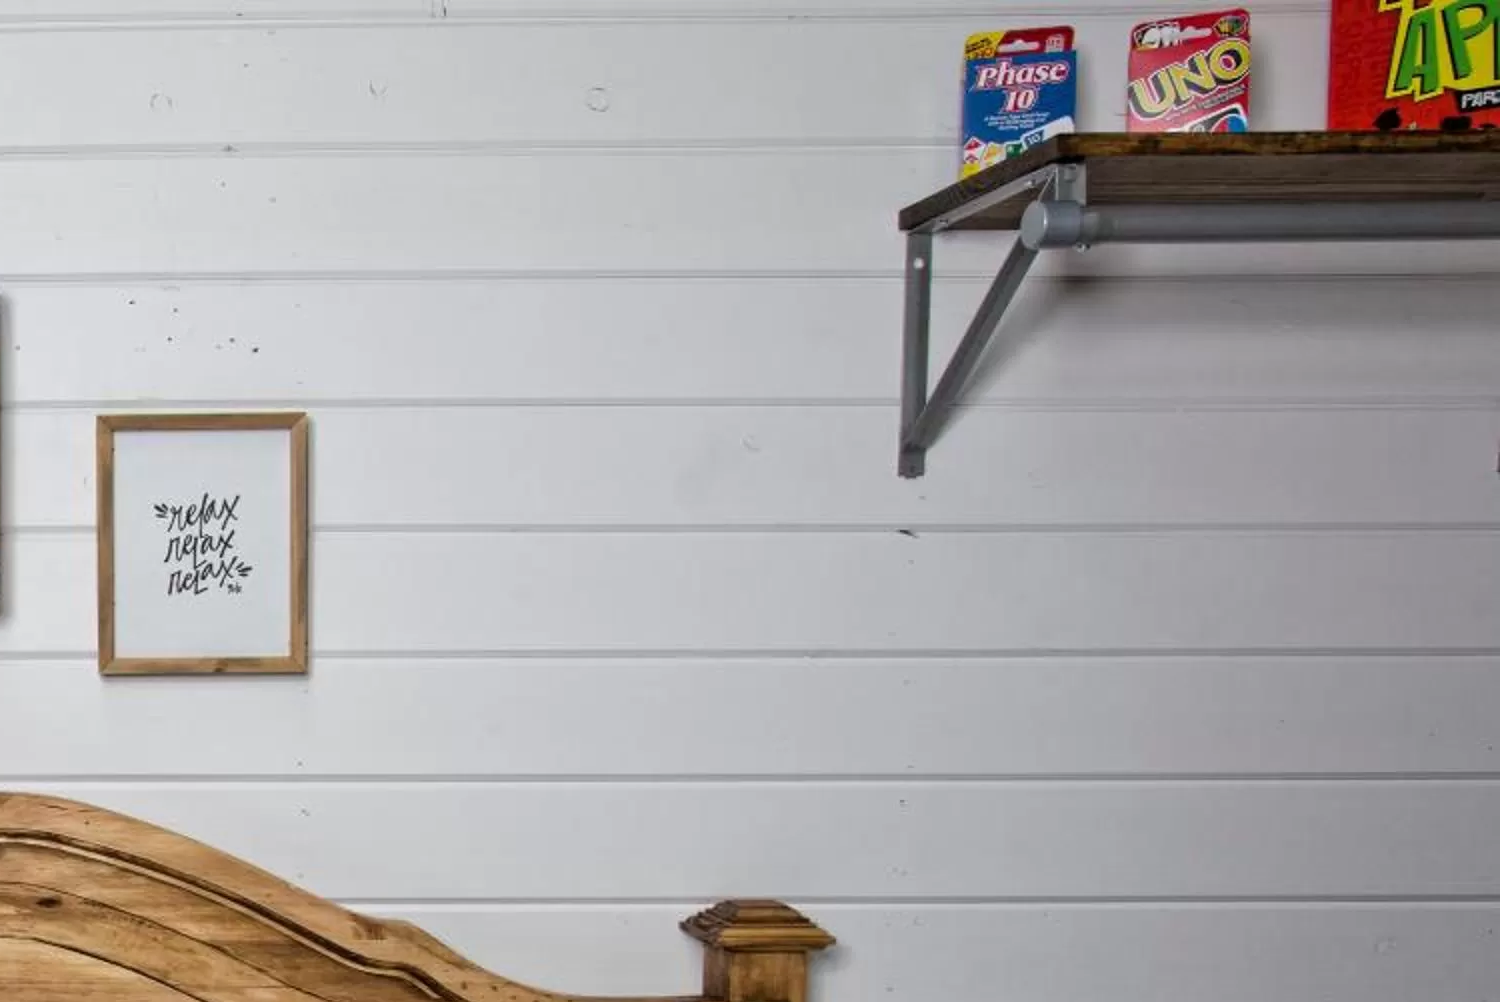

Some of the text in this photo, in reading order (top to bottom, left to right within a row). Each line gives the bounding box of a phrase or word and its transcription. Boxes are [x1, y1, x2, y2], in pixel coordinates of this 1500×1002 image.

[1394, 0, 1500, 93] AP
[976, 57, 1069, 89] Phase
[1128, 40, 1250, 119] UNO
[1002, 87, 1038, 112] 10
[167, 493, 240, 539] relax
[164, 530, 235, 568] relax
[168, 556, 238, 595] relax
